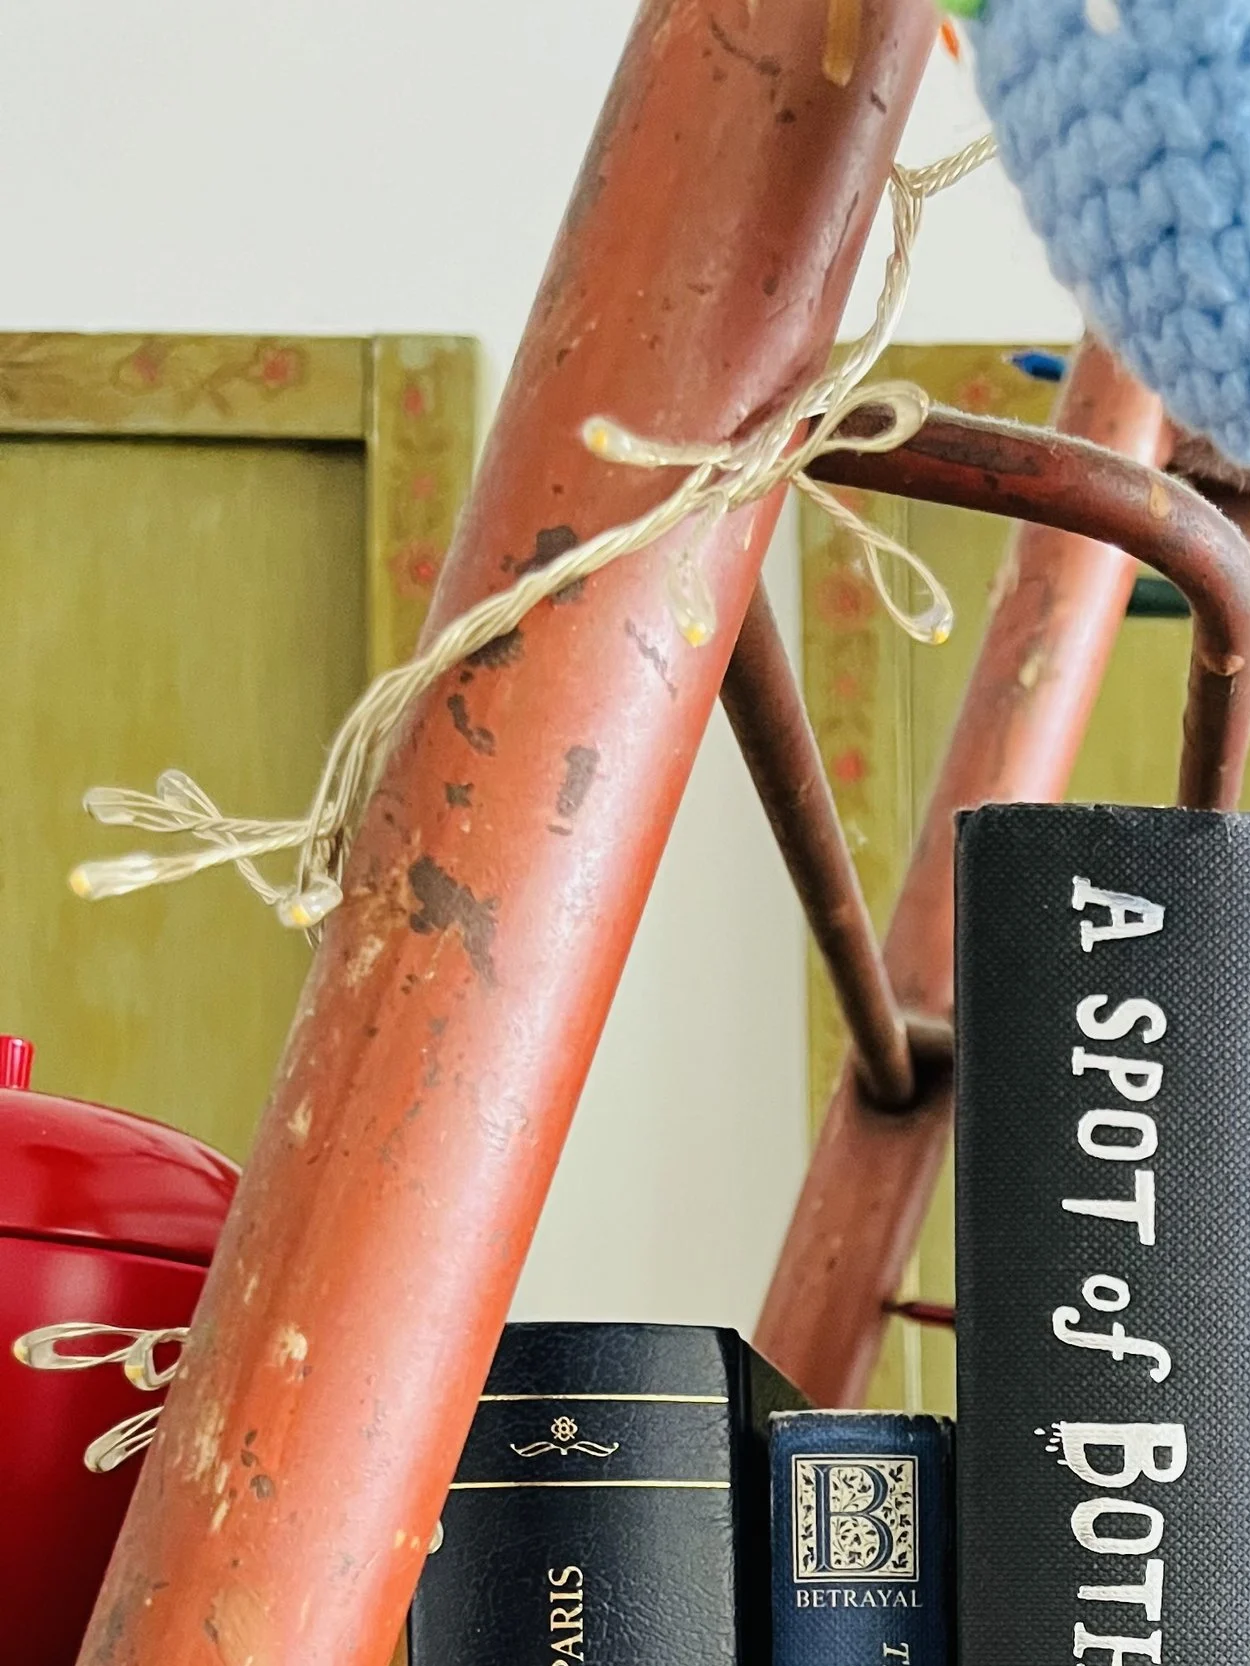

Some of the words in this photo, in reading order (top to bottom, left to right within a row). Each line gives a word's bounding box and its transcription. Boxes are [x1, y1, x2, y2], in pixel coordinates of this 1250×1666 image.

[1071, 874, 1165, 953] A
[1061, 992, 1168, 1246] SPOT
[1051, 1272, 1172, 1384] of
[809, 1462, 894, 1574] B
[795, 1588, 924, 1609] BETRAYAL
